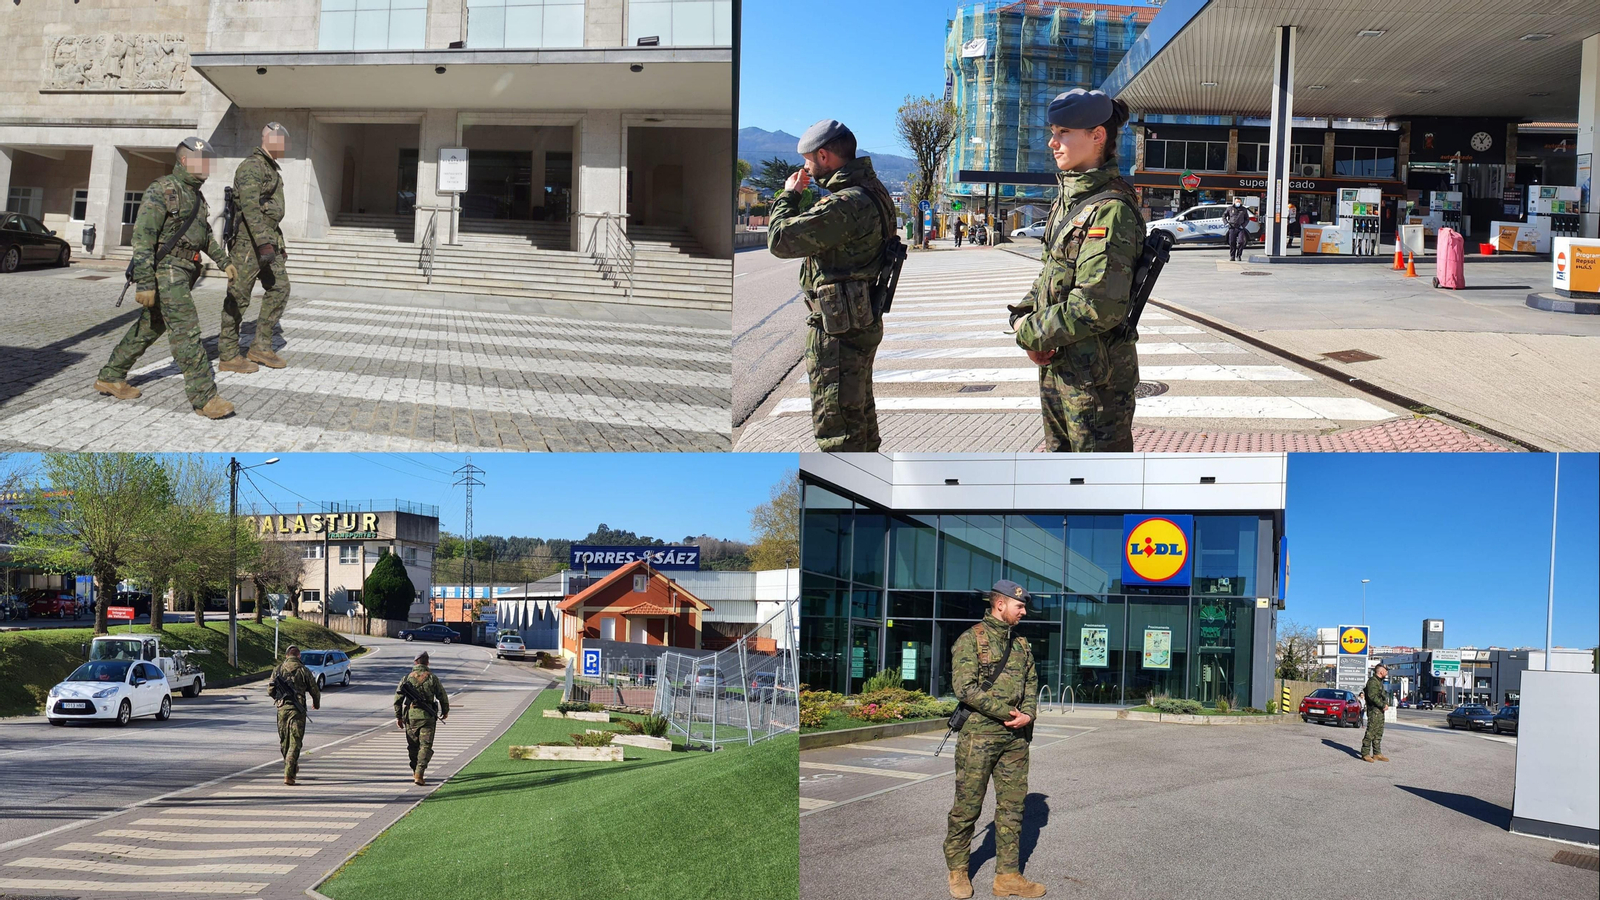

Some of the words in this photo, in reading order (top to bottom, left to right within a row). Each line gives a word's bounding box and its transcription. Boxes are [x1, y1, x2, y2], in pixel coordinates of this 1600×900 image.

[1239, 179, 1316, 189] supercado
[574, 551, 635, 564] TORRES
[653, 549, 697, 565] SÁEZ
[586, 653, 598, 668] P
